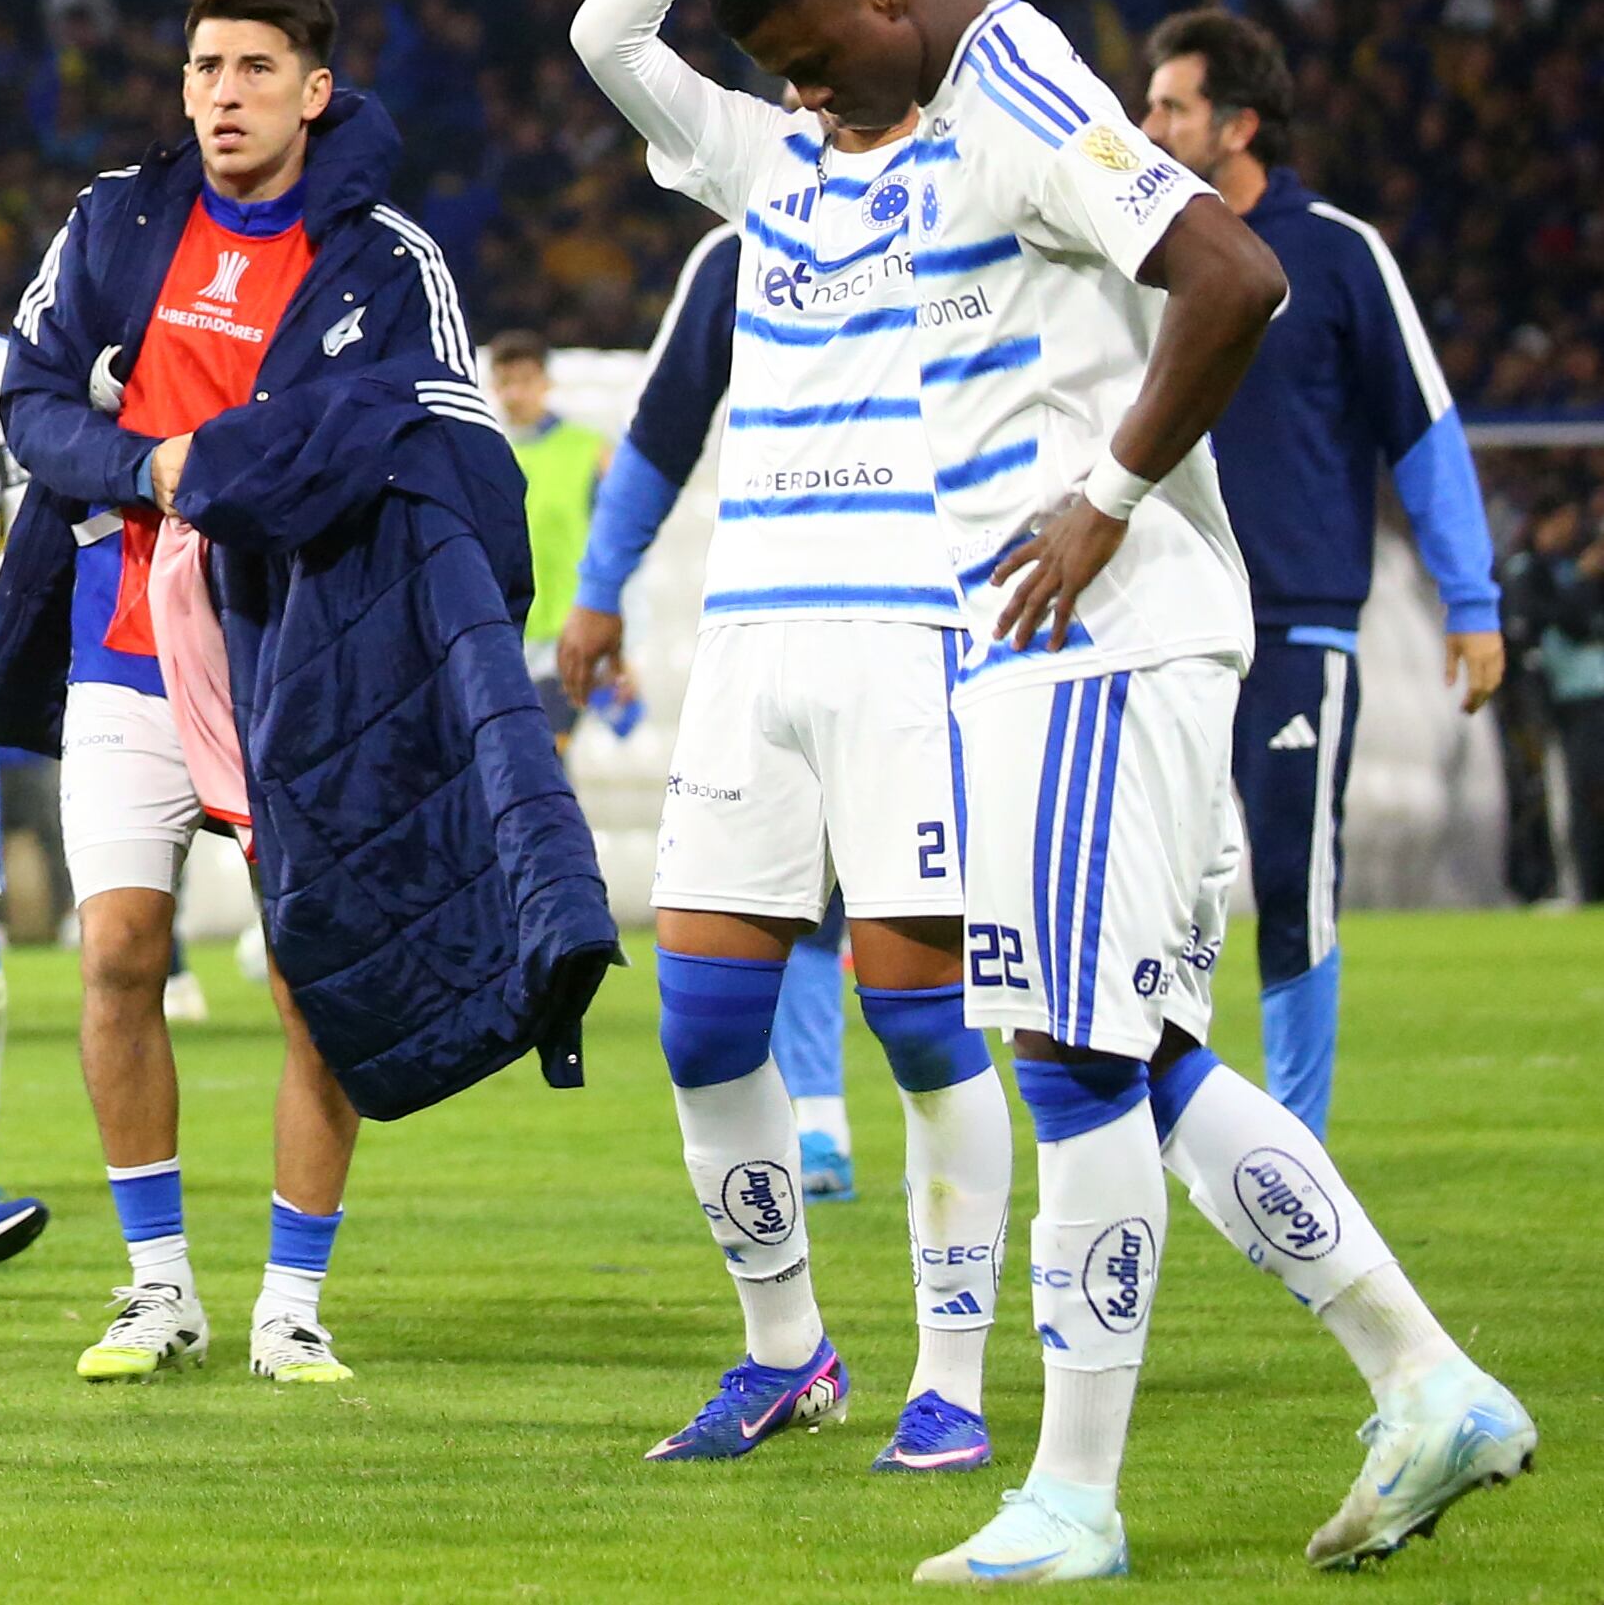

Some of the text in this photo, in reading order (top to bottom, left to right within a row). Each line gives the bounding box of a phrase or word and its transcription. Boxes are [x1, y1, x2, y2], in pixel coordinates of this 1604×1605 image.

[157, 305, 264, 343] LIBERTADORES
[968, 923, 1030, 990] 22
[739, 1169, 788, 1236] Kodilar
[1244, 1162, 1329, 1250] Kodilar
[920, 1245, 990, 1265] CEC
[1106, 1227, 1142, 1320] Kodilar
